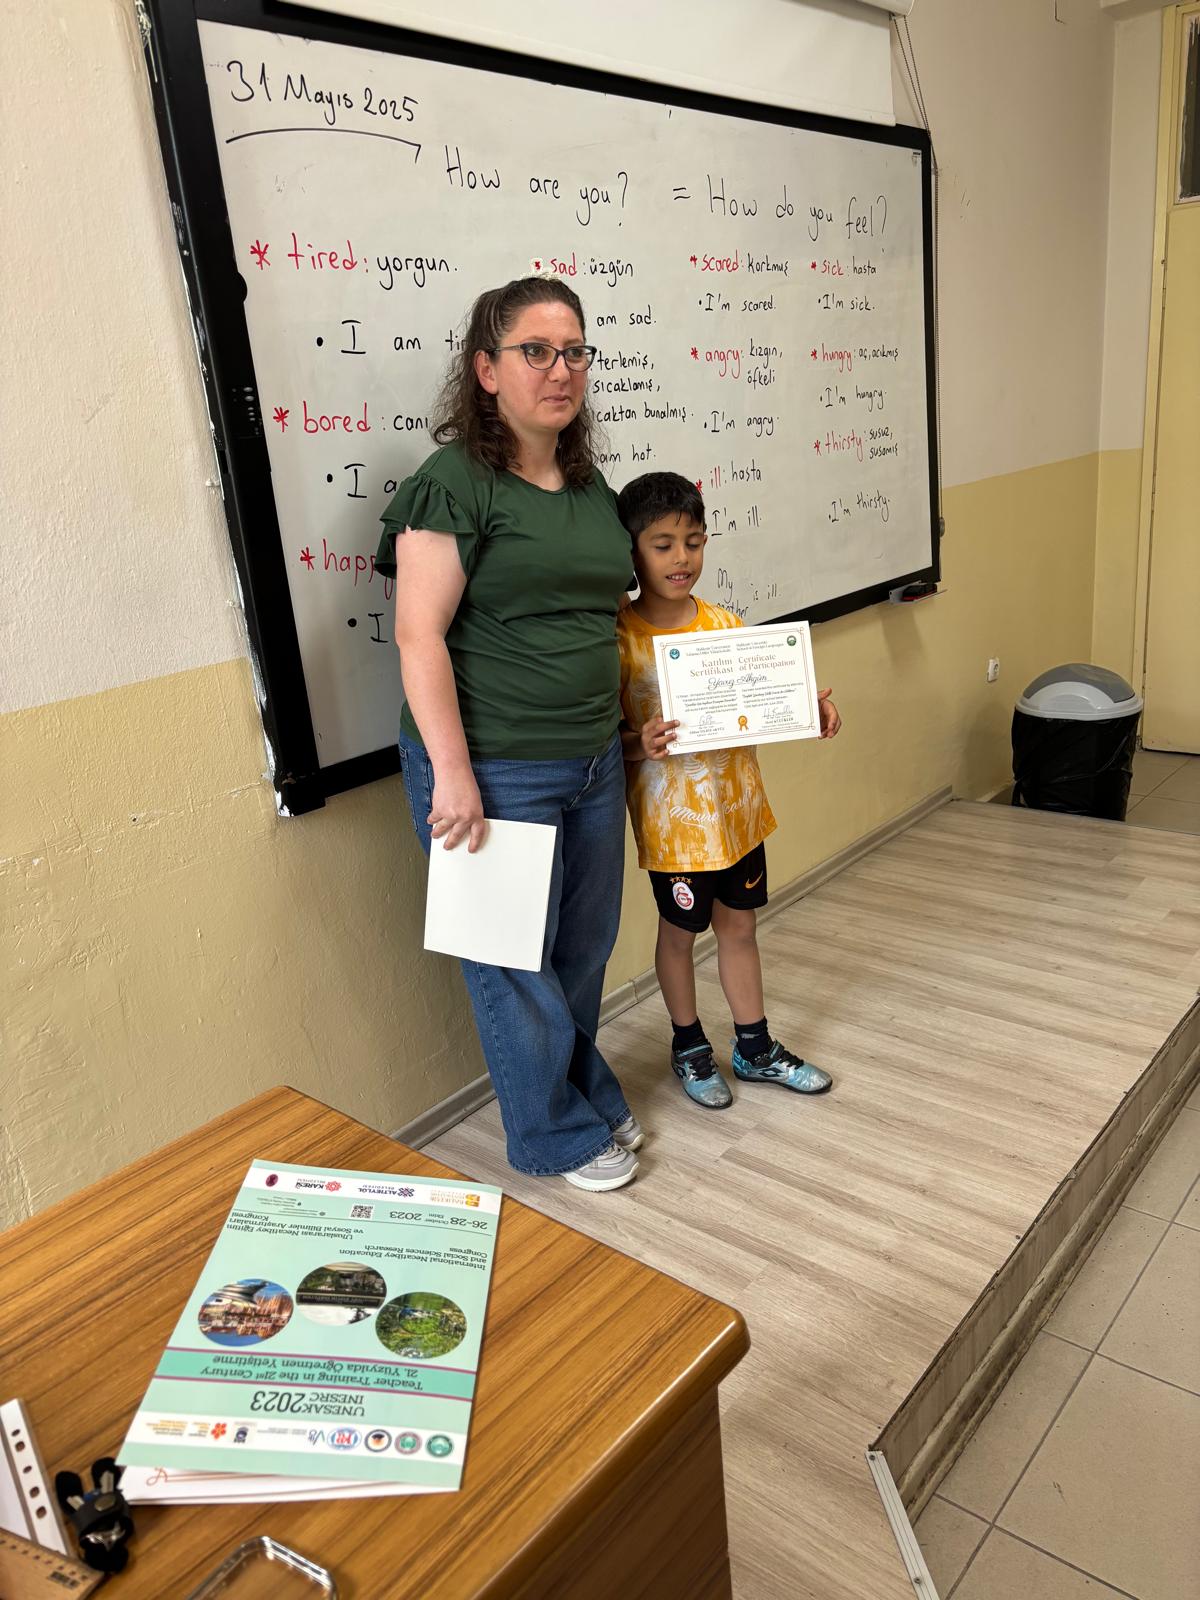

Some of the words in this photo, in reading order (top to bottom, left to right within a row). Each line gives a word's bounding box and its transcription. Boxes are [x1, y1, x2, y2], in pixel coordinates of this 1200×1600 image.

[226, 60, 272, 102] 31
[363, 87, 419, 122] 2025
[445, 145, 501, 190] How
[529, 177, 561, 199] are
[576, 171, 628, 227] you?
[707, 174, 758, 216] How
[776, 185, 794, 218] do
[808, 206, 833, 242] you
[846, 195, 888, 253] feel?
[287, 232, 369, 273] tired:
[376, 256, 458, 291] yorgun.
[701, 249, 744, 272] scared:
[852, 255, 877, 275] hasta
[589, 257, 634, 288] üzgün
[705, 293, 730, 311] I'm
[823, 293, 844, 309] I'm
[850, 296, 875, 311] sick.
[596, 315, 617, 327] am
[629, 304, 657, 325] sad.
[341, 319, 367, 354] I
[394, 336, 422, 350] am
[825, 385, 846, 408] I'm
[711, 410, 735, 433] I'm
[600, 452, 621, 464] am
[632, 443, 657, 462] hot.
[731, 458, 762, 481] hasta
[344, 463, 368, 499] I
[832, 498, 851, 523] I'm
[711, 507, 737, 537] I'm
[717, 567, 733, 604] My
[367, 612, 389, 643] I
[389, 1210, 423, 1221] 2023
[450, 1217, 488, 1230] 26-28
[339, 1248, 383, 1260] Education
[364, 1244, 404, 1255] Research
[405, 1247, 443, 1259] Sciences
[444, 1251, 471, 1262] Social
[449, 1247, 488, 1259] Congress
[432, 1255, 486, 1270] International
[472, 1255, 487, 1264] and
[199, 1365, 253, 1380] Century
[279, 1370, 300, 1381] the
[302, 1371, 315, 1381] in
[316, 1371, 371, 1386] Training
[375, 1376, 423, 1390] Teacher
[250, 1391, 306, 1412] 2023
[309, 1391, 364, 1405] INESRC
[302, 1403, 365, 1417] UNESAK
